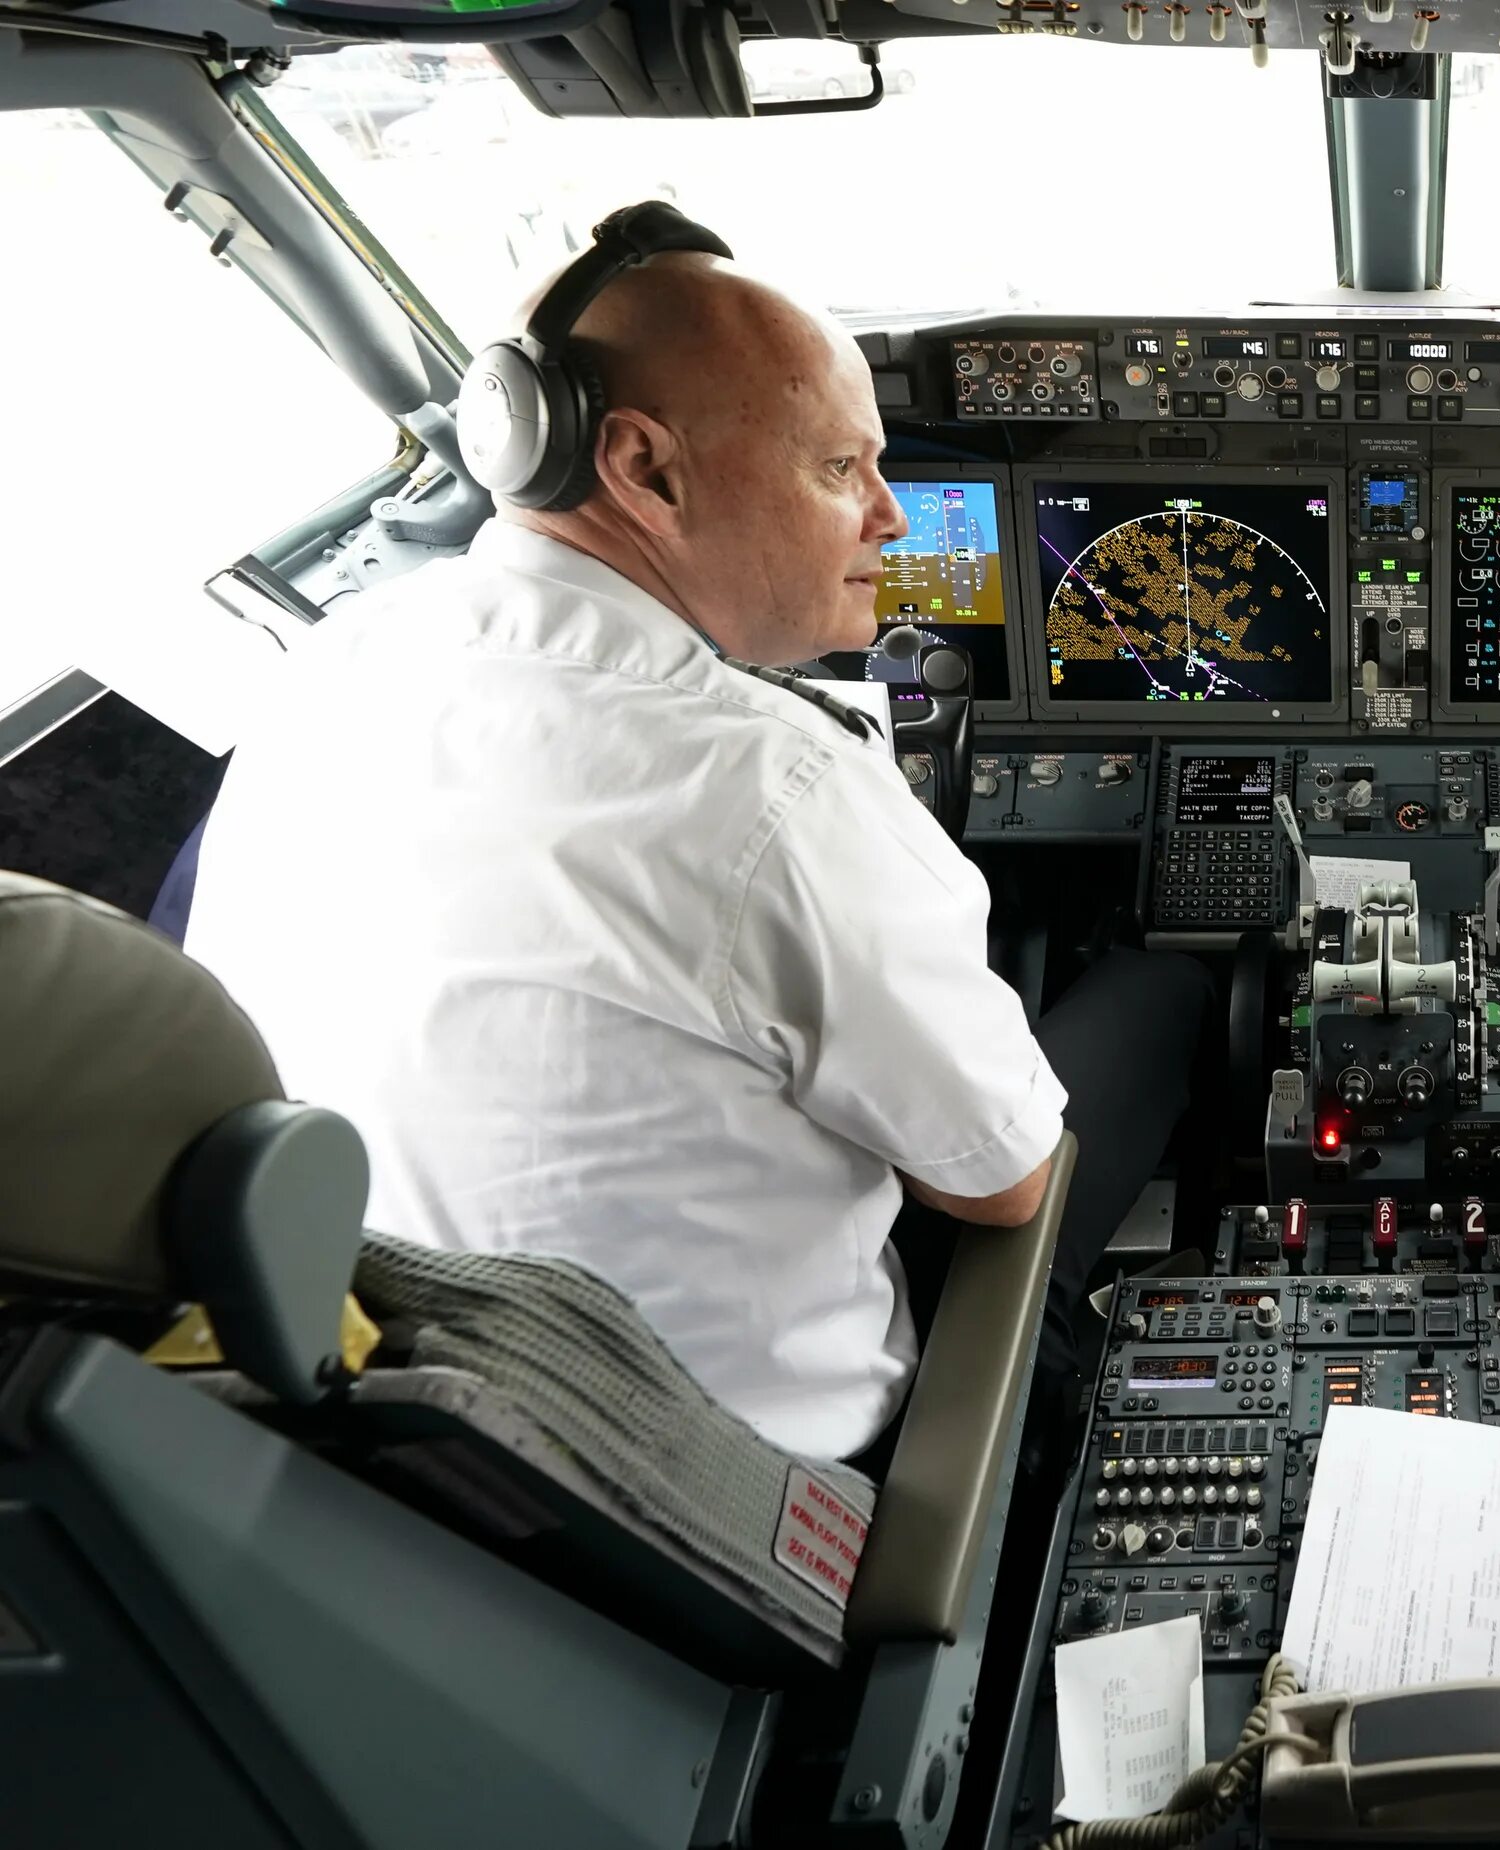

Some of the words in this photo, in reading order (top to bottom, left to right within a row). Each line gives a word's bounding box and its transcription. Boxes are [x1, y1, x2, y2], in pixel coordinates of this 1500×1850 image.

[1136, 340, 1158, 353] 176
[1242, 342, 1263, 354] 146
[1320, 343, 1341, 356] 176
[1410, 344, 1447, 358] 10000
[1344, 969, 1350, 982] 1
[1418, 969, 1426, 982] 2
[1290, 1205, 1299, 1235] 1
[1380, 1203, 1390, 1234] APU
[1466, 1203, 1485, 1233] 2
